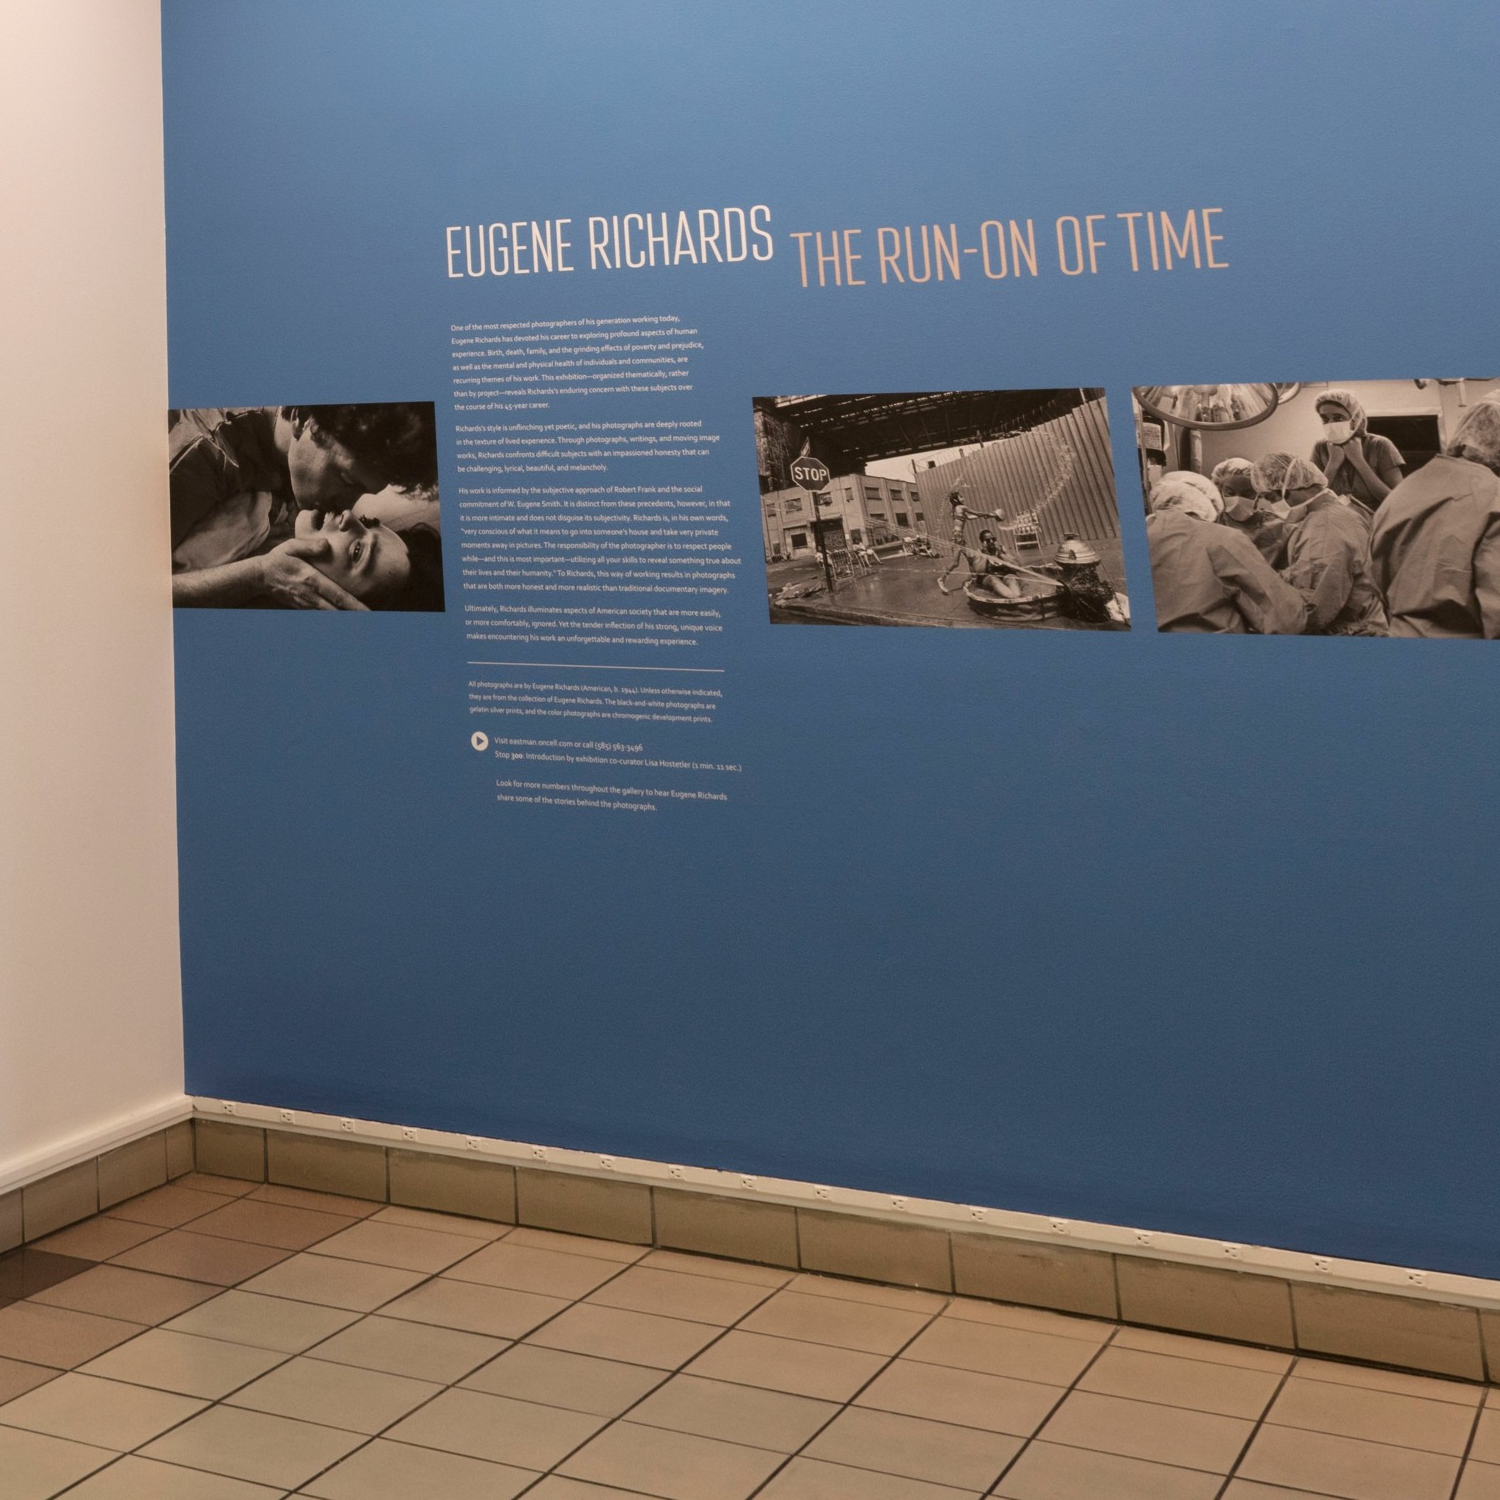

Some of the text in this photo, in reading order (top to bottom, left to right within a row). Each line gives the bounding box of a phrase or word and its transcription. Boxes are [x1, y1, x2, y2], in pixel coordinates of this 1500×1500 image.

[446, 204, 774, 279] EUGENE RICHARDS
[790, 207, 1229, 288] THE RUN-ON OF TIME
[500, 321, 531, 331] respected
[531, 319, 578, 330] photographers
[596, 317, 632, 327] generation
[632, 316, 659, 326] working
[659, 315, 680, 325] today,
[451, 337, 474, 346] Eugene
[475, 336, 501, 344] Richards
[579, 331, 609, 341] exploring
[610, 330, 640, 340] profound
[641, 329, 666, 338] aspects
[452, 349, 486, 359] experience.
[487, 348, 504, 358] Birth,
[506, 348, 525, 357] death,
[526, 347, 548, 356] family,
[574, 345, 600, 355] grinding
[601, 344, 623, 352] effects
[632, 343, 657, 353] poverty
[671, 342, 704, 352] prejudice,
[528, 361, 554, 370] physical
[632, 357, 676, 366] communities,
[466, 465, 504, 474] challenging,
[504, 465, 525, 474] lyrical,
[525, 464, 556, 473] beautiful,
[570, 464, 608, 473] melancholy.
[794, 467, 826, 481] STOP
[488, 633, 530, 643] encountering
[566, 635, 611, 645] unforgettable
[625, 636, 660, 646] rewarding
[660, 637, 699, 647] experience.
[494, 737, 509, 745] Visit
[509, 738, 574, 748] eastman.oncell.com
[612, 742, 644, 752] 563-3496
[495, 751, 510, 761] Stop
[526, 753, 566, 762] Introduction
[566, 755, 575, 764] by
[576, 755, 608, 764] exhibition
[609, 757, 644, 766] co-curator
[644, 759, 659, 767] Lisa
[659, 760, 691, 768] Hostetler
[700, 762, 715, 770] min.
[496, 779, 513, 788] Look
[542, 782, 571, 791] numbers
[571, 784, 609, 795] throughout
[609, 786, 621, 794] the
[622, 787, 645, 797] gallery
[653, 788, 670, 797] hear
[670, 789, 698, 800] Eugene
[697, 791, 728, 800] Richards
[497, 794, 515, 802] share
[542, 796, 553, 805] the
[554, 797, 576, 806] stories
[576, 799, 600, 807] behind
[600, 800, 612, 808] the
[613, 801, 657, 812] photographs.
